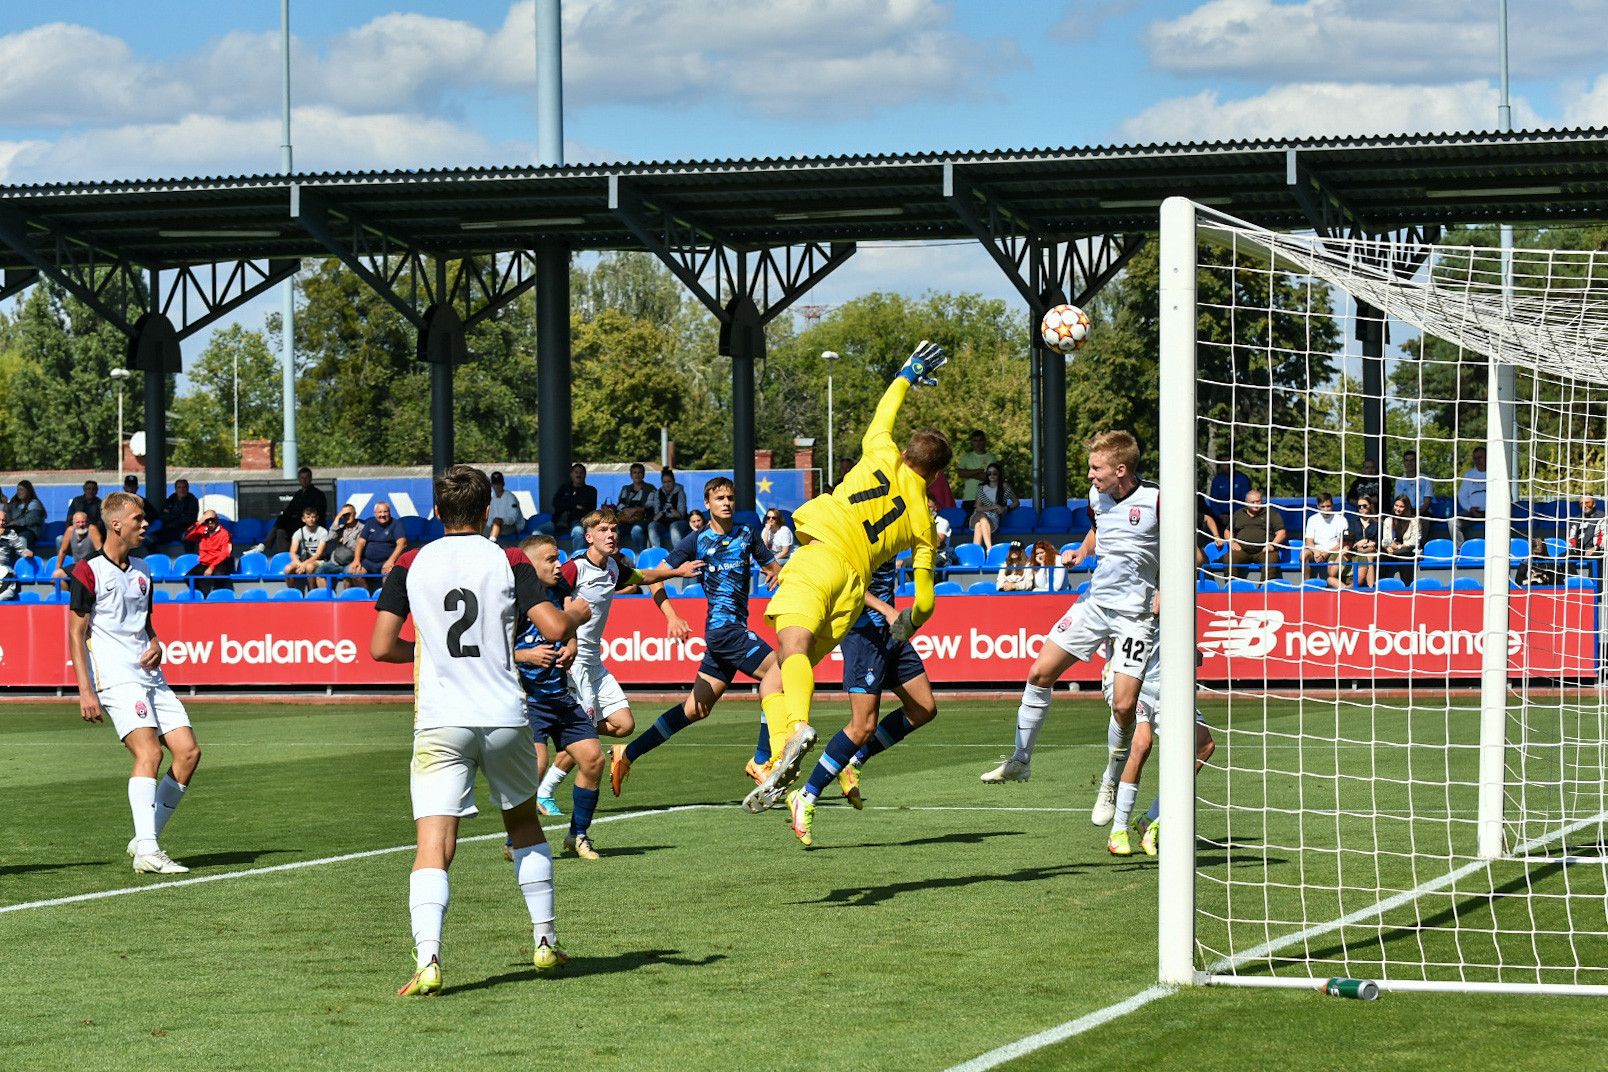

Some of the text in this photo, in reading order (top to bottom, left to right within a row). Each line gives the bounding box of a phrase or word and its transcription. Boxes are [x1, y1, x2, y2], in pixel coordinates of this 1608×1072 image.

[848, 469, 906, 545] 71
[444, 587, 480, 658] 2
[221, 634, 357, 664] balance
[600, 630, 706, 662] alanc
[910, 627, 1050, 661] ew bala
[1122, 637, 1145, 663] 42
[1285, 631, 1360, 657] new
